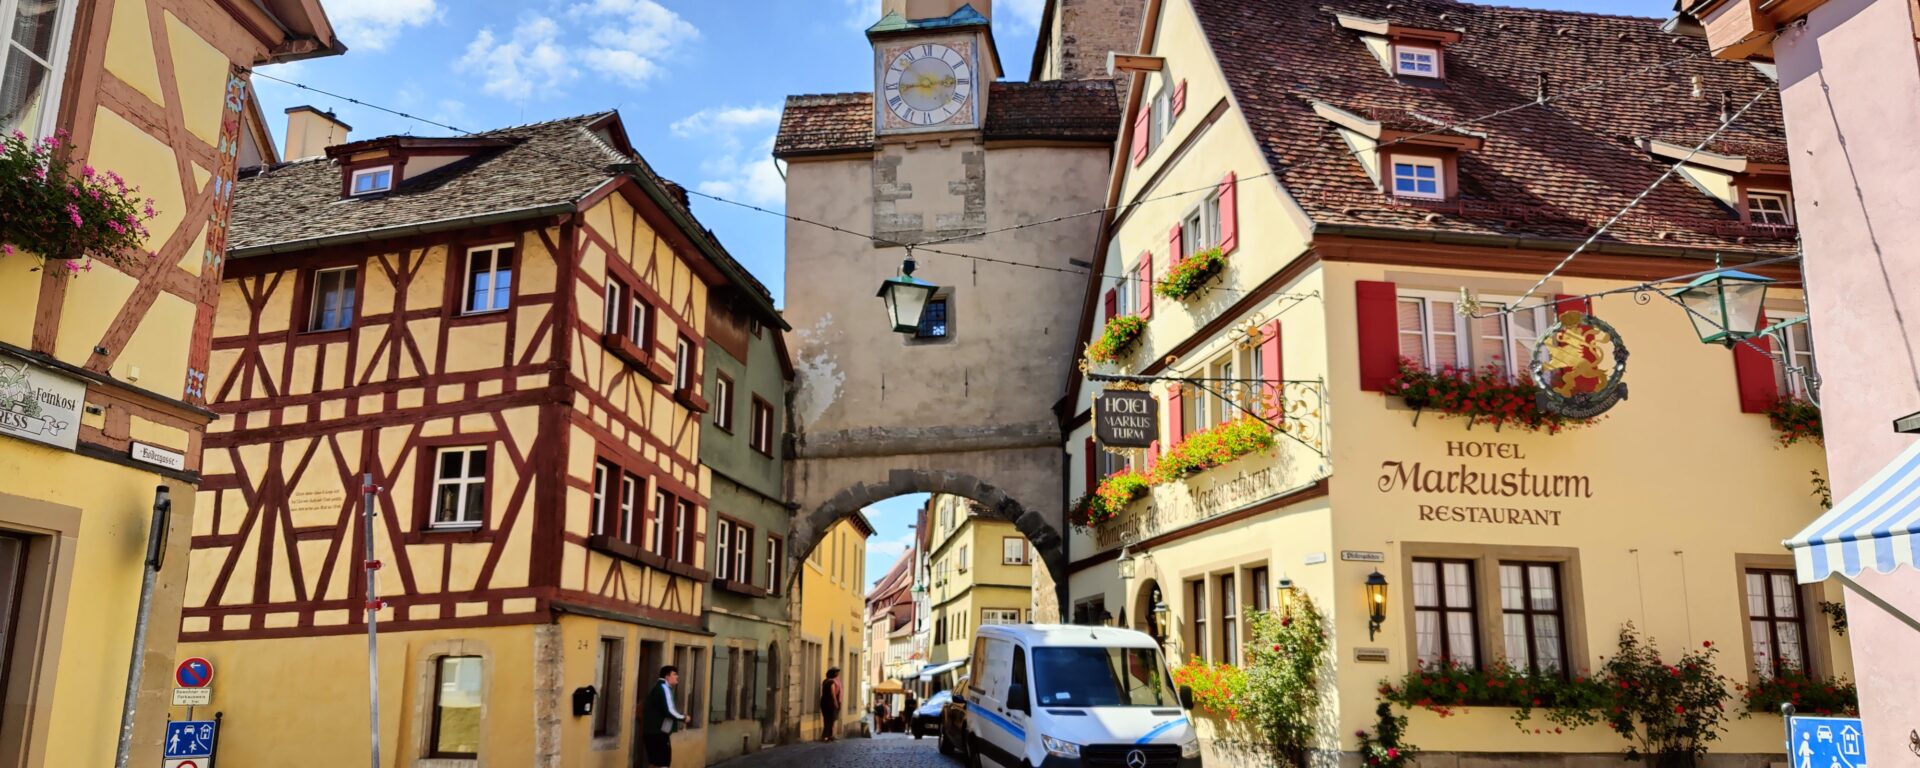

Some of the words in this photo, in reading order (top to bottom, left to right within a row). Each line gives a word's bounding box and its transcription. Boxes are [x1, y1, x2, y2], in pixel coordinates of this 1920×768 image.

[36, 387, 76, 411] Feinkost
[1105, 397, 1148, 414] HOTEL
[1104, 416, 1151, 429] MARKUS
[1112, 427, 1144, 440] TURM
[1446, 441, 1526, 460] HOTEL
[1377, 460, 1594, 498] Markusturm
[1419, 505, 1562, 526] RESTAURANT
